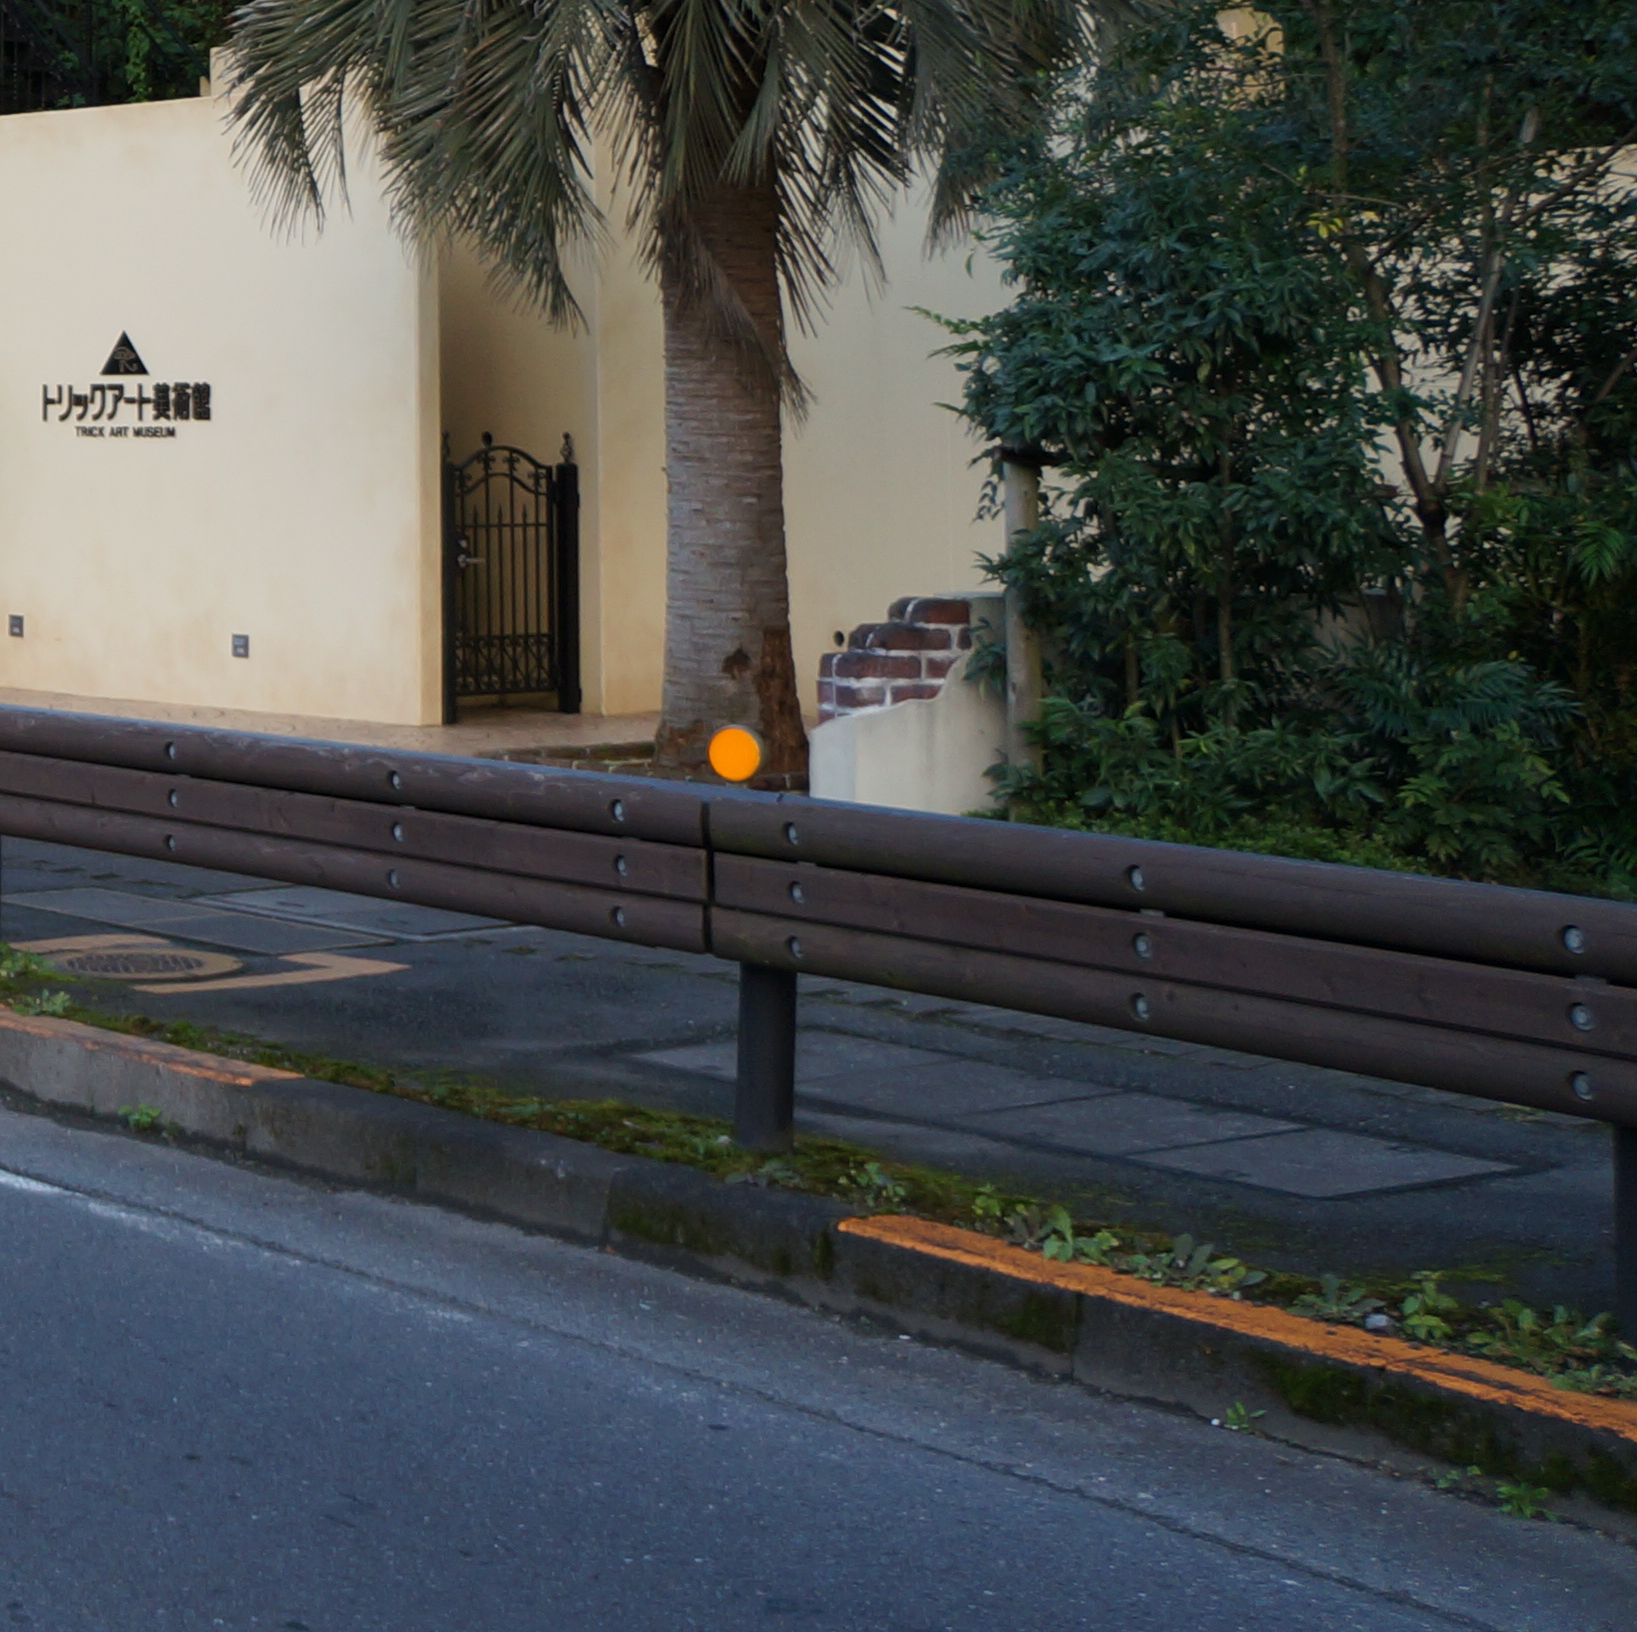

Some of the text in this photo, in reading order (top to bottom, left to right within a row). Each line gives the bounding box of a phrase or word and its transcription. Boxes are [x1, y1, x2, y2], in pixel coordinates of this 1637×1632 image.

[41, 382, 212, 422] トリックアート美術館
[75, 426, 177, 439] TRICK ART MUSEUM
